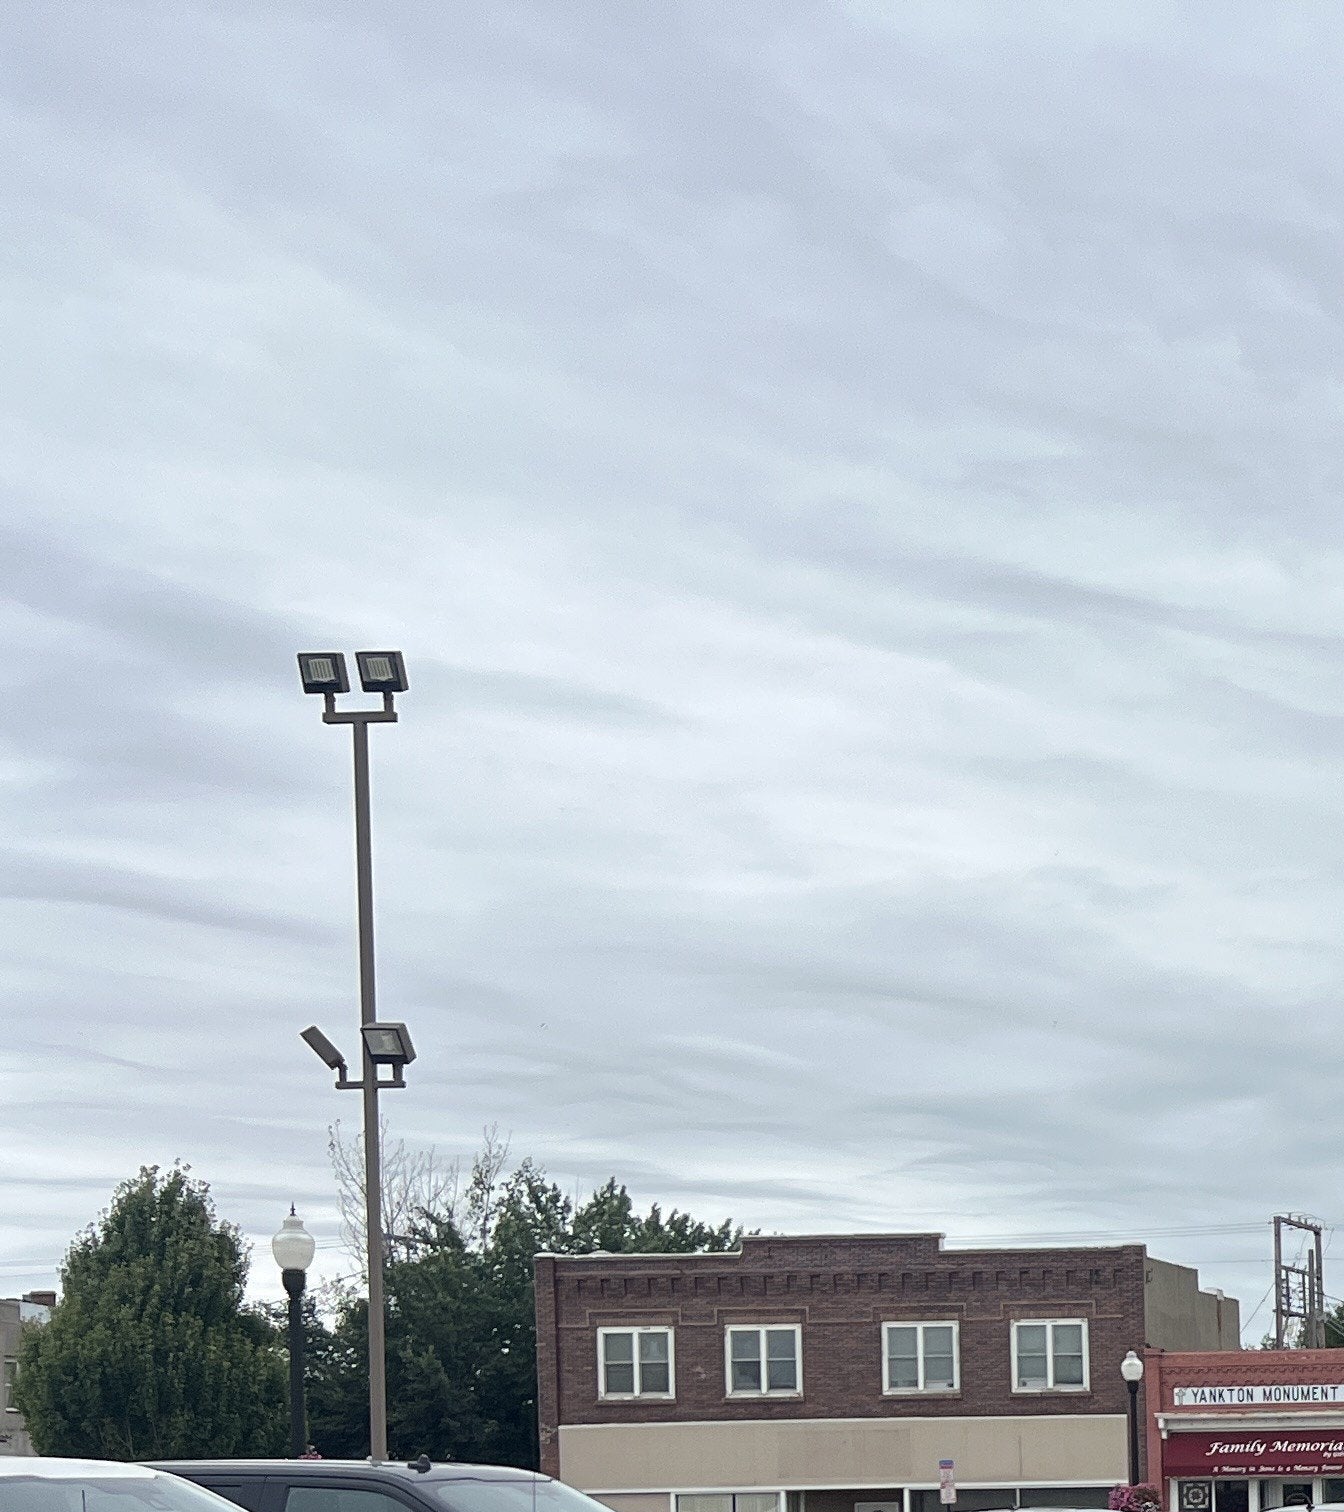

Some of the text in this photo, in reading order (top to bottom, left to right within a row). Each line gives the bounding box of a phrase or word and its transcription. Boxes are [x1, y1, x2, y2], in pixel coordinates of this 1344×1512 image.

[1191, 1388, 1254, 1403] YANKTON
[1262, 1386, 1339, 1402] MONUMENT
[1205, 1439, 1267, 1457] Family
